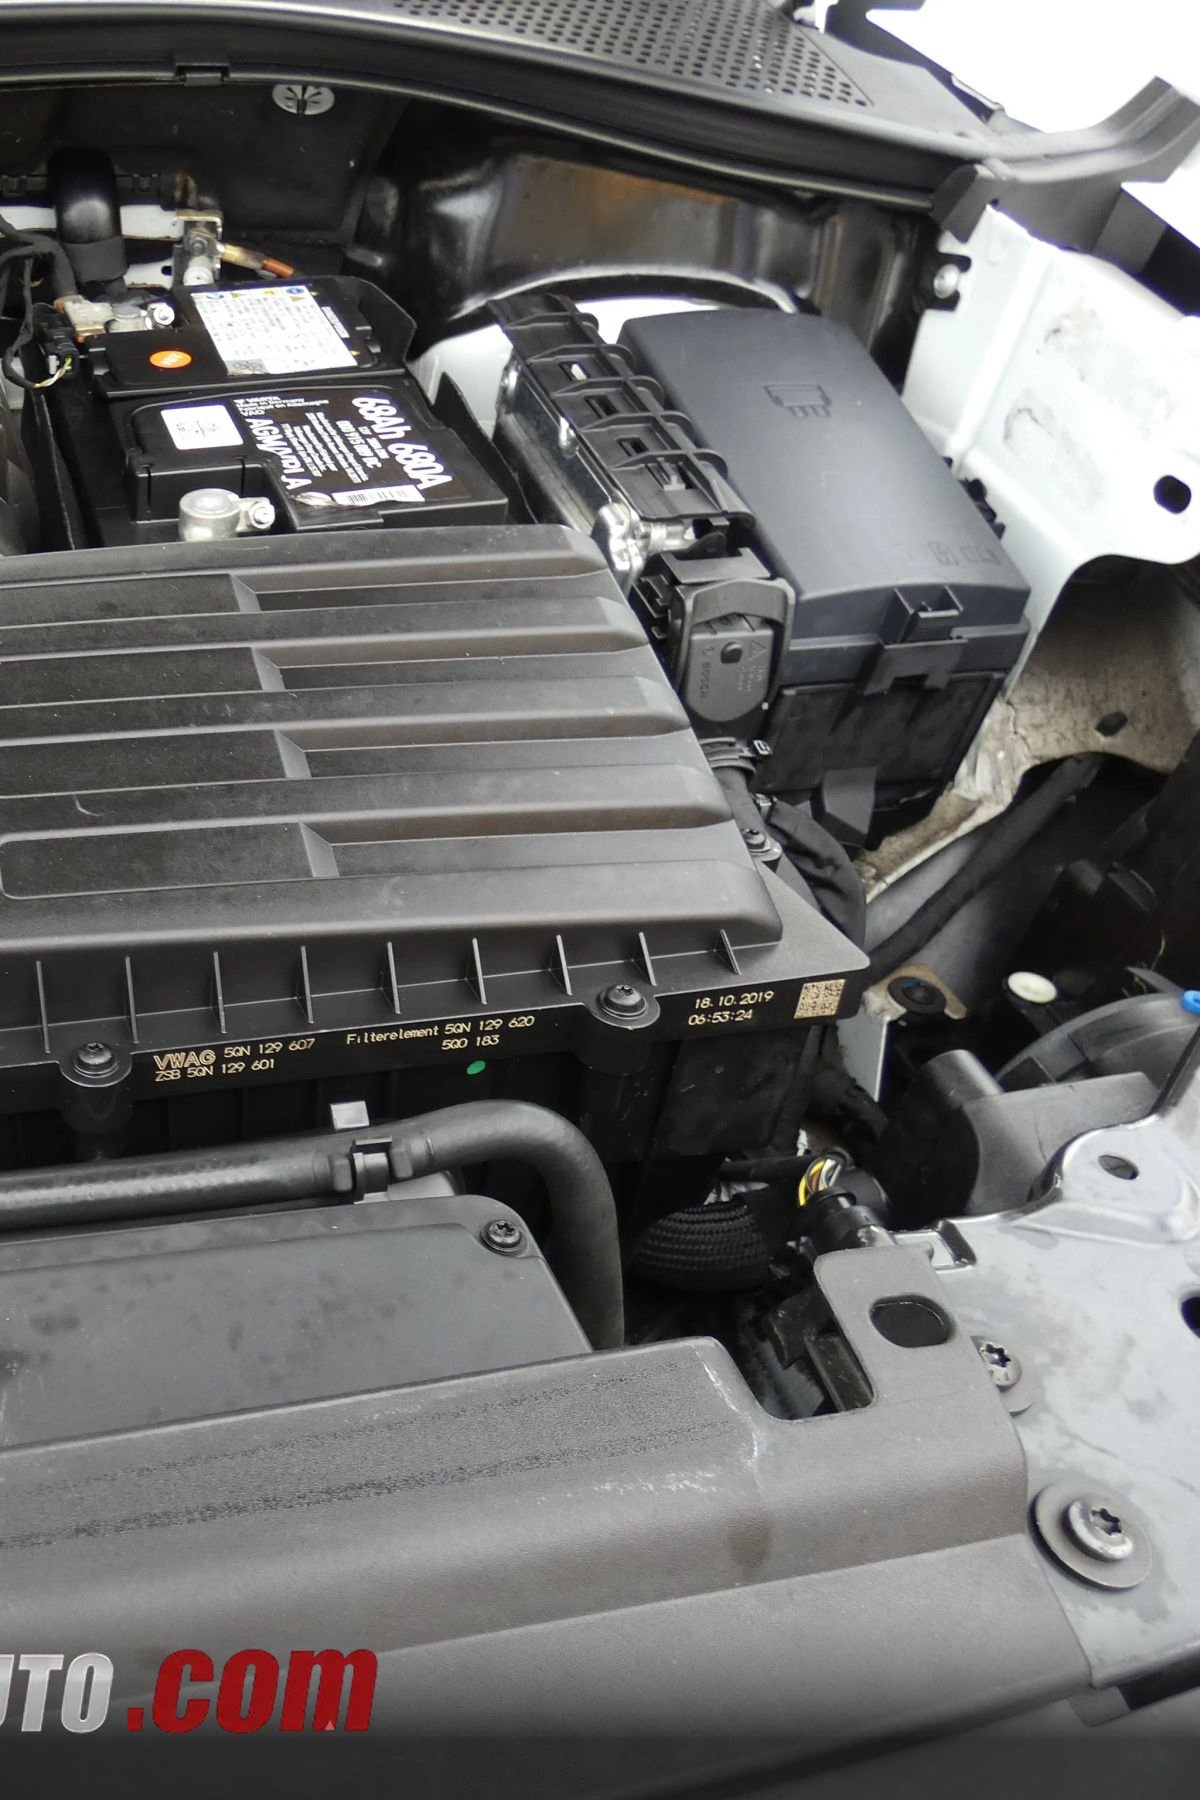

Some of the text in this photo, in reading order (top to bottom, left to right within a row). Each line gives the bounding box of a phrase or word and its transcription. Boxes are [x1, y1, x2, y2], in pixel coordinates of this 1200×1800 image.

[352, 397, 452, 490] 68Ah 680A
[346, 1015, 535, 1045] Filterelement 5QN 129 620
[688, 1009, 753, 1026] 06:53:24
[476, 1034, 500, 1047] 183
[153, 1038, 316, 1071] VWAG 5QN 129 607
[155, 1058, 275, 1082] ZSB 5QN 129 601
